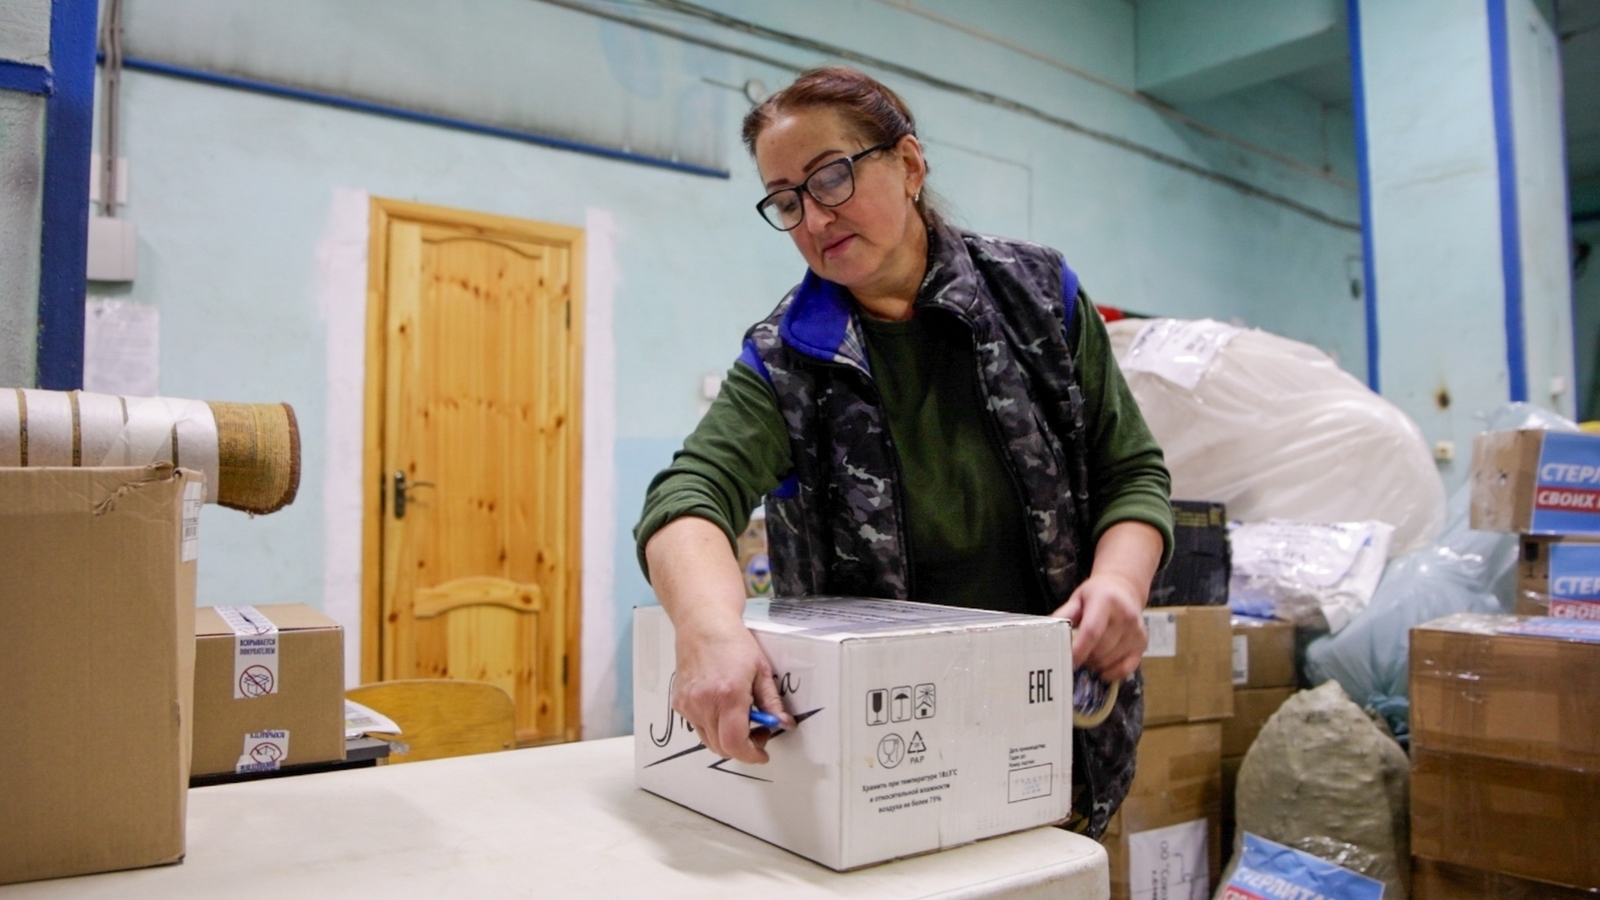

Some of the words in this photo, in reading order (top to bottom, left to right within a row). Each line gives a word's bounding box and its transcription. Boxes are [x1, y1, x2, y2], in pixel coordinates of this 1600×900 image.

[1538, 491, 1597, 509] СВОИХ
[910, 755, 925, 764] PAP
[862, 782, 887, 793] Хранить
[888, 780, 900, 789] при
[900, 773, 938, 785] температуре
[874, 788, 919, 802] относительной
[919, 783, 950, 794] влажности
[878, 803, 903, 813] воздуха
[911, 798, 929, 807] более
